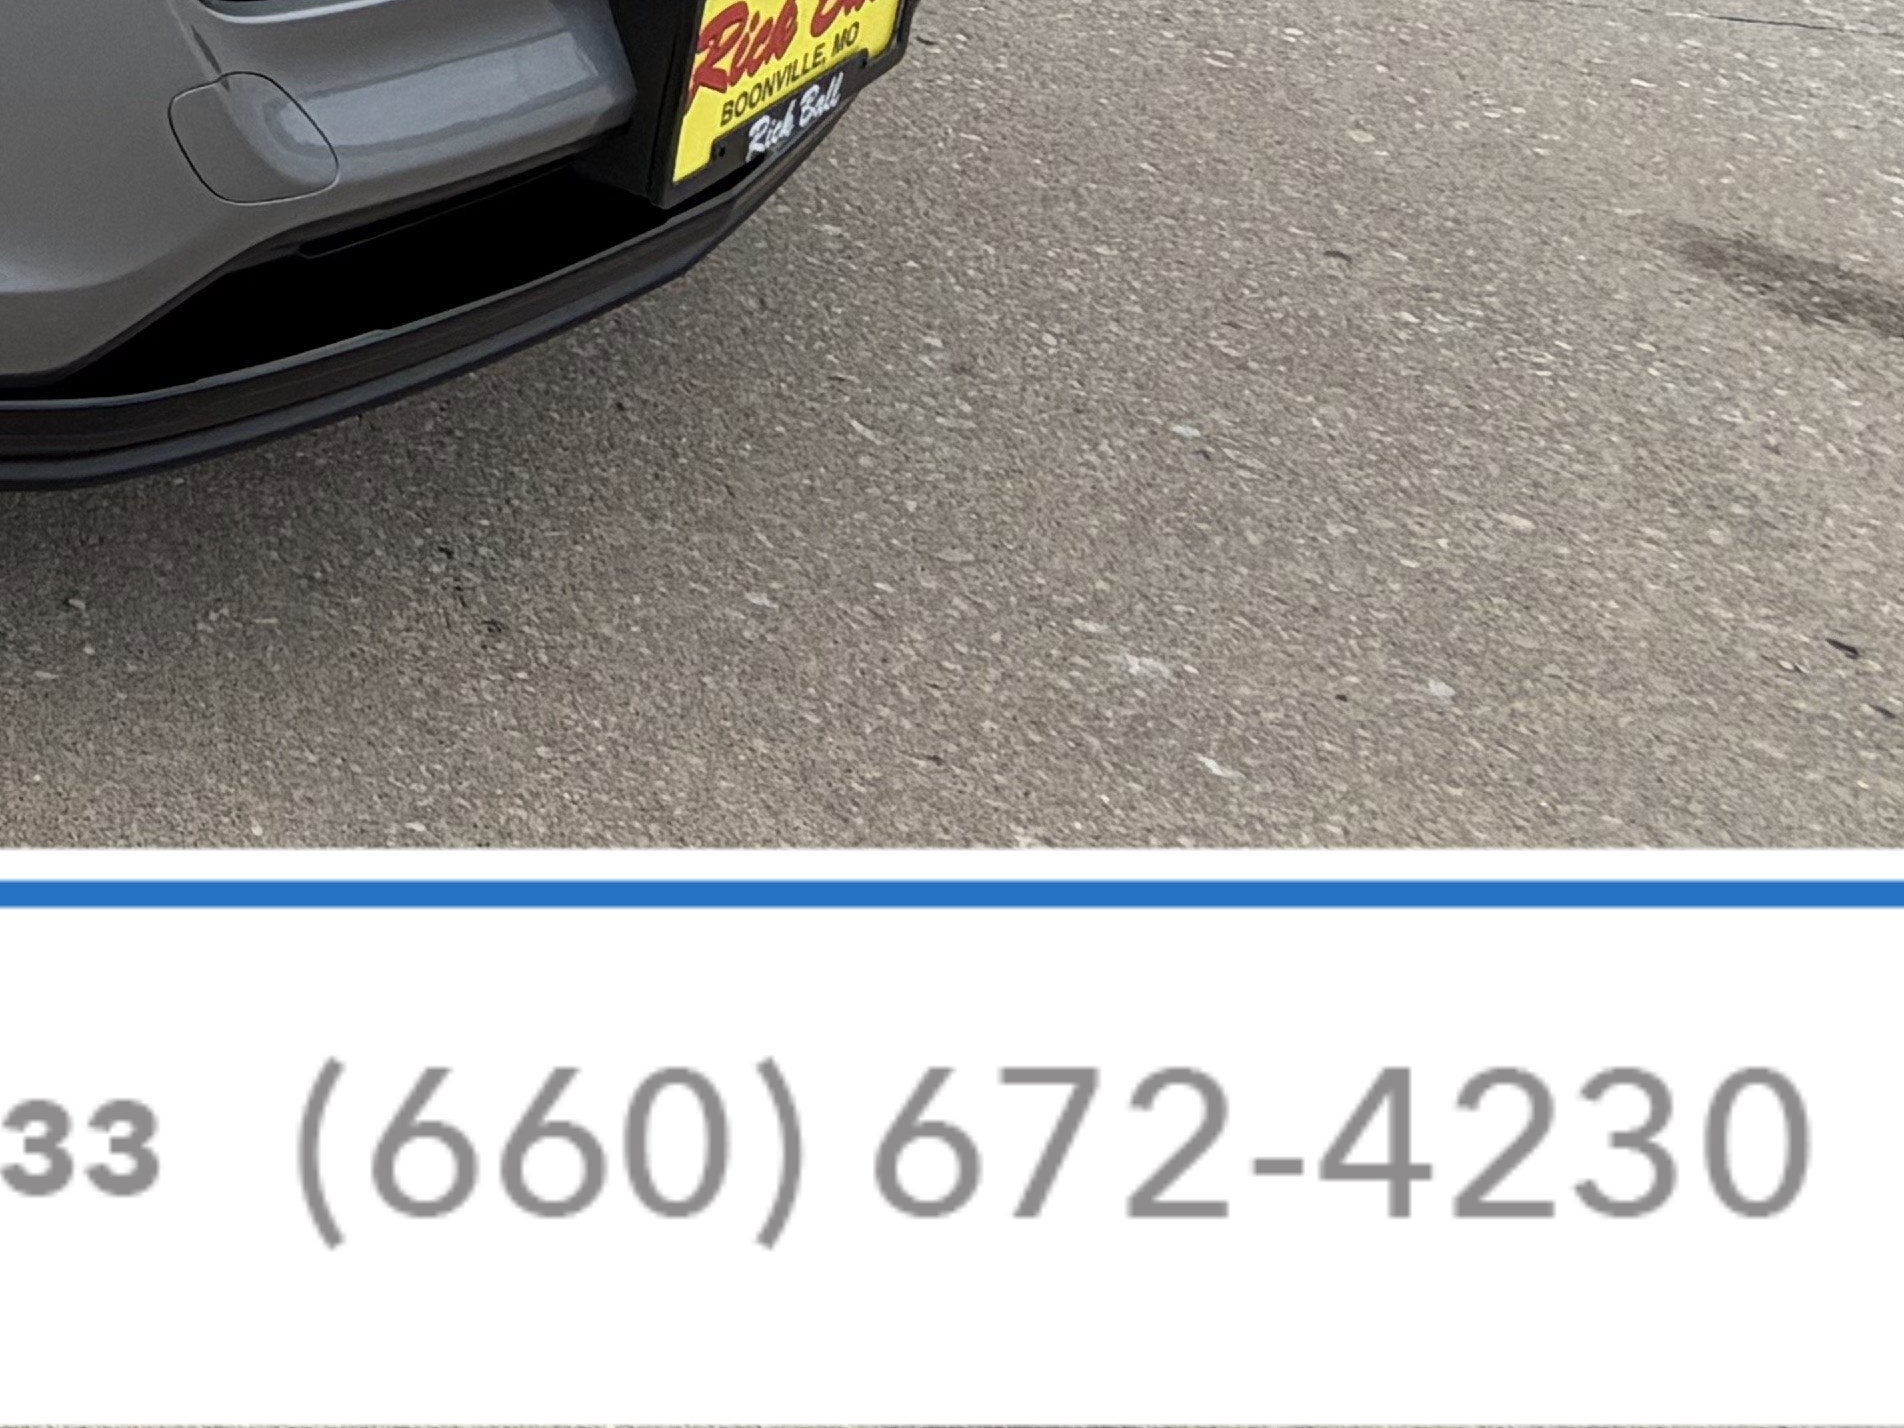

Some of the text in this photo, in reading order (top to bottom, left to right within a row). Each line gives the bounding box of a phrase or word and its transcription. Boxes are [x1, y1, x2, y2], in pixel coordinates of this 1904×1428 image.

[720, 21, 860, 127] BOONVILLE, MO
[745, 71, 844, 163] Rick Ball
